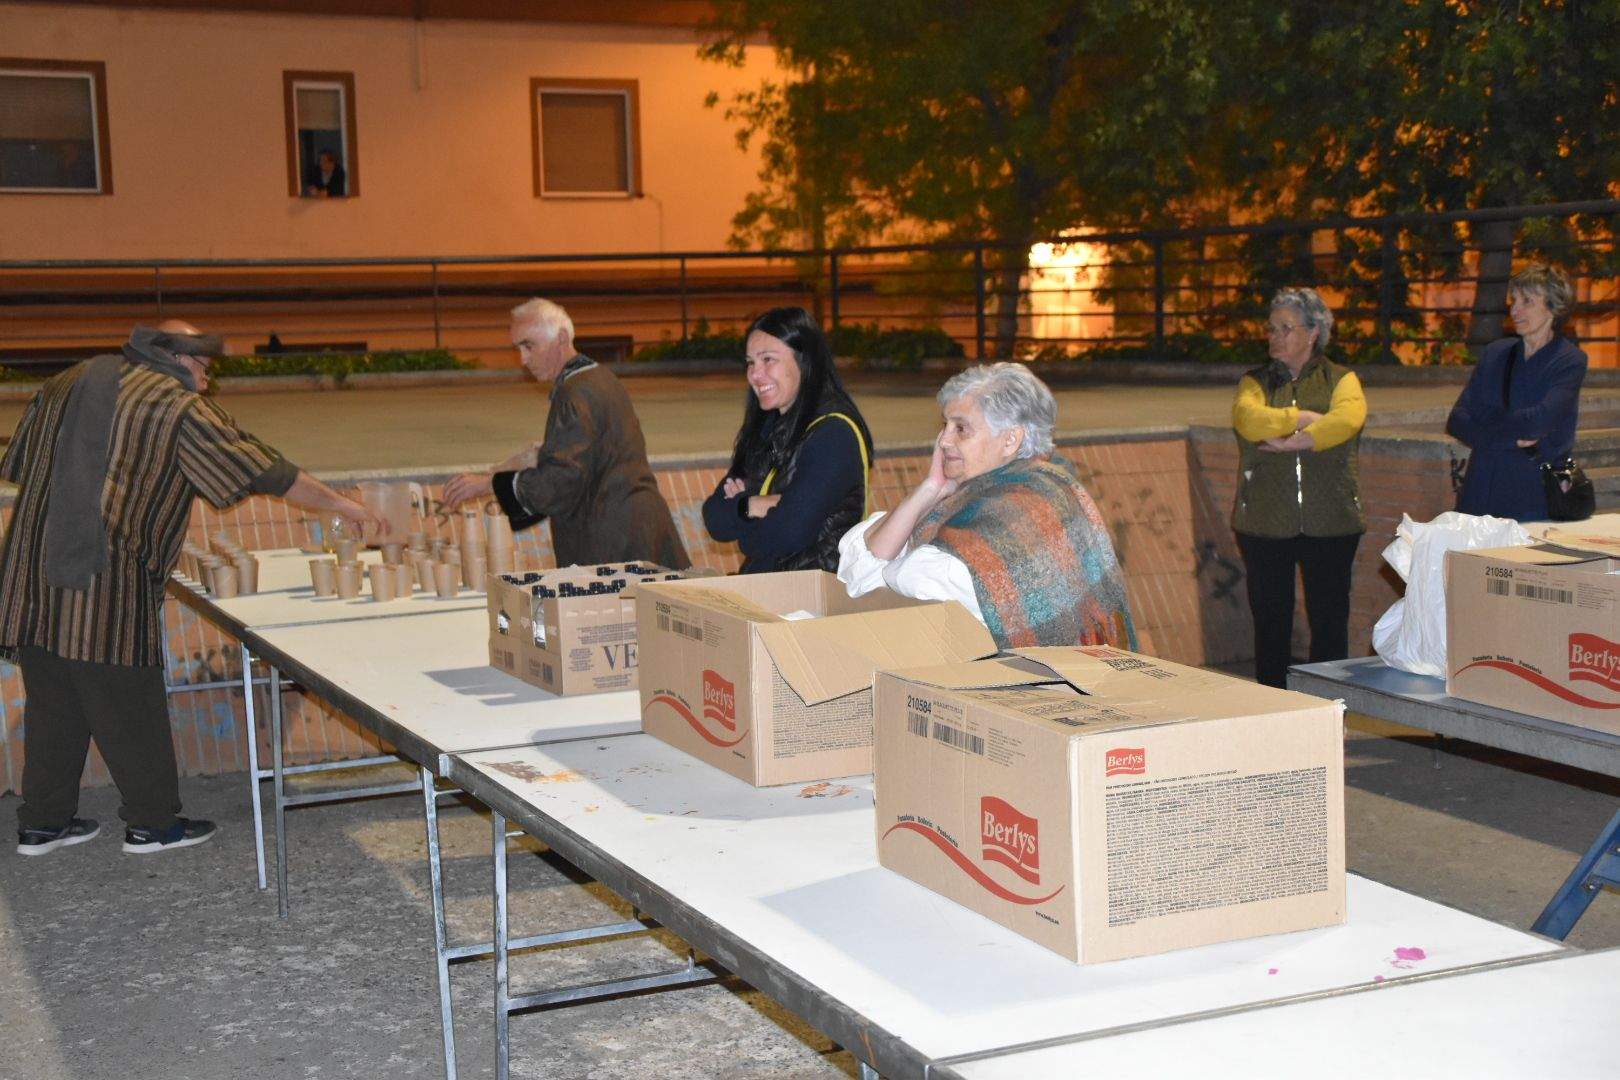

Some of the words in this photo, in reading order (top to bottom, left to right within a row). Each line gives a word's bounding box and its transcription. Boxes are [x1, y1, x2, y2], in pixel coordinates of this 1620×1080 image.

[1485, 566, 1513, 578] 210584
[704, 681, 734, 714] Berlys
[907, 695, 932, 714] 210584
[1107, 753, 1144, 769] Berlys
[983, 810, 1036, 861] Berlys
